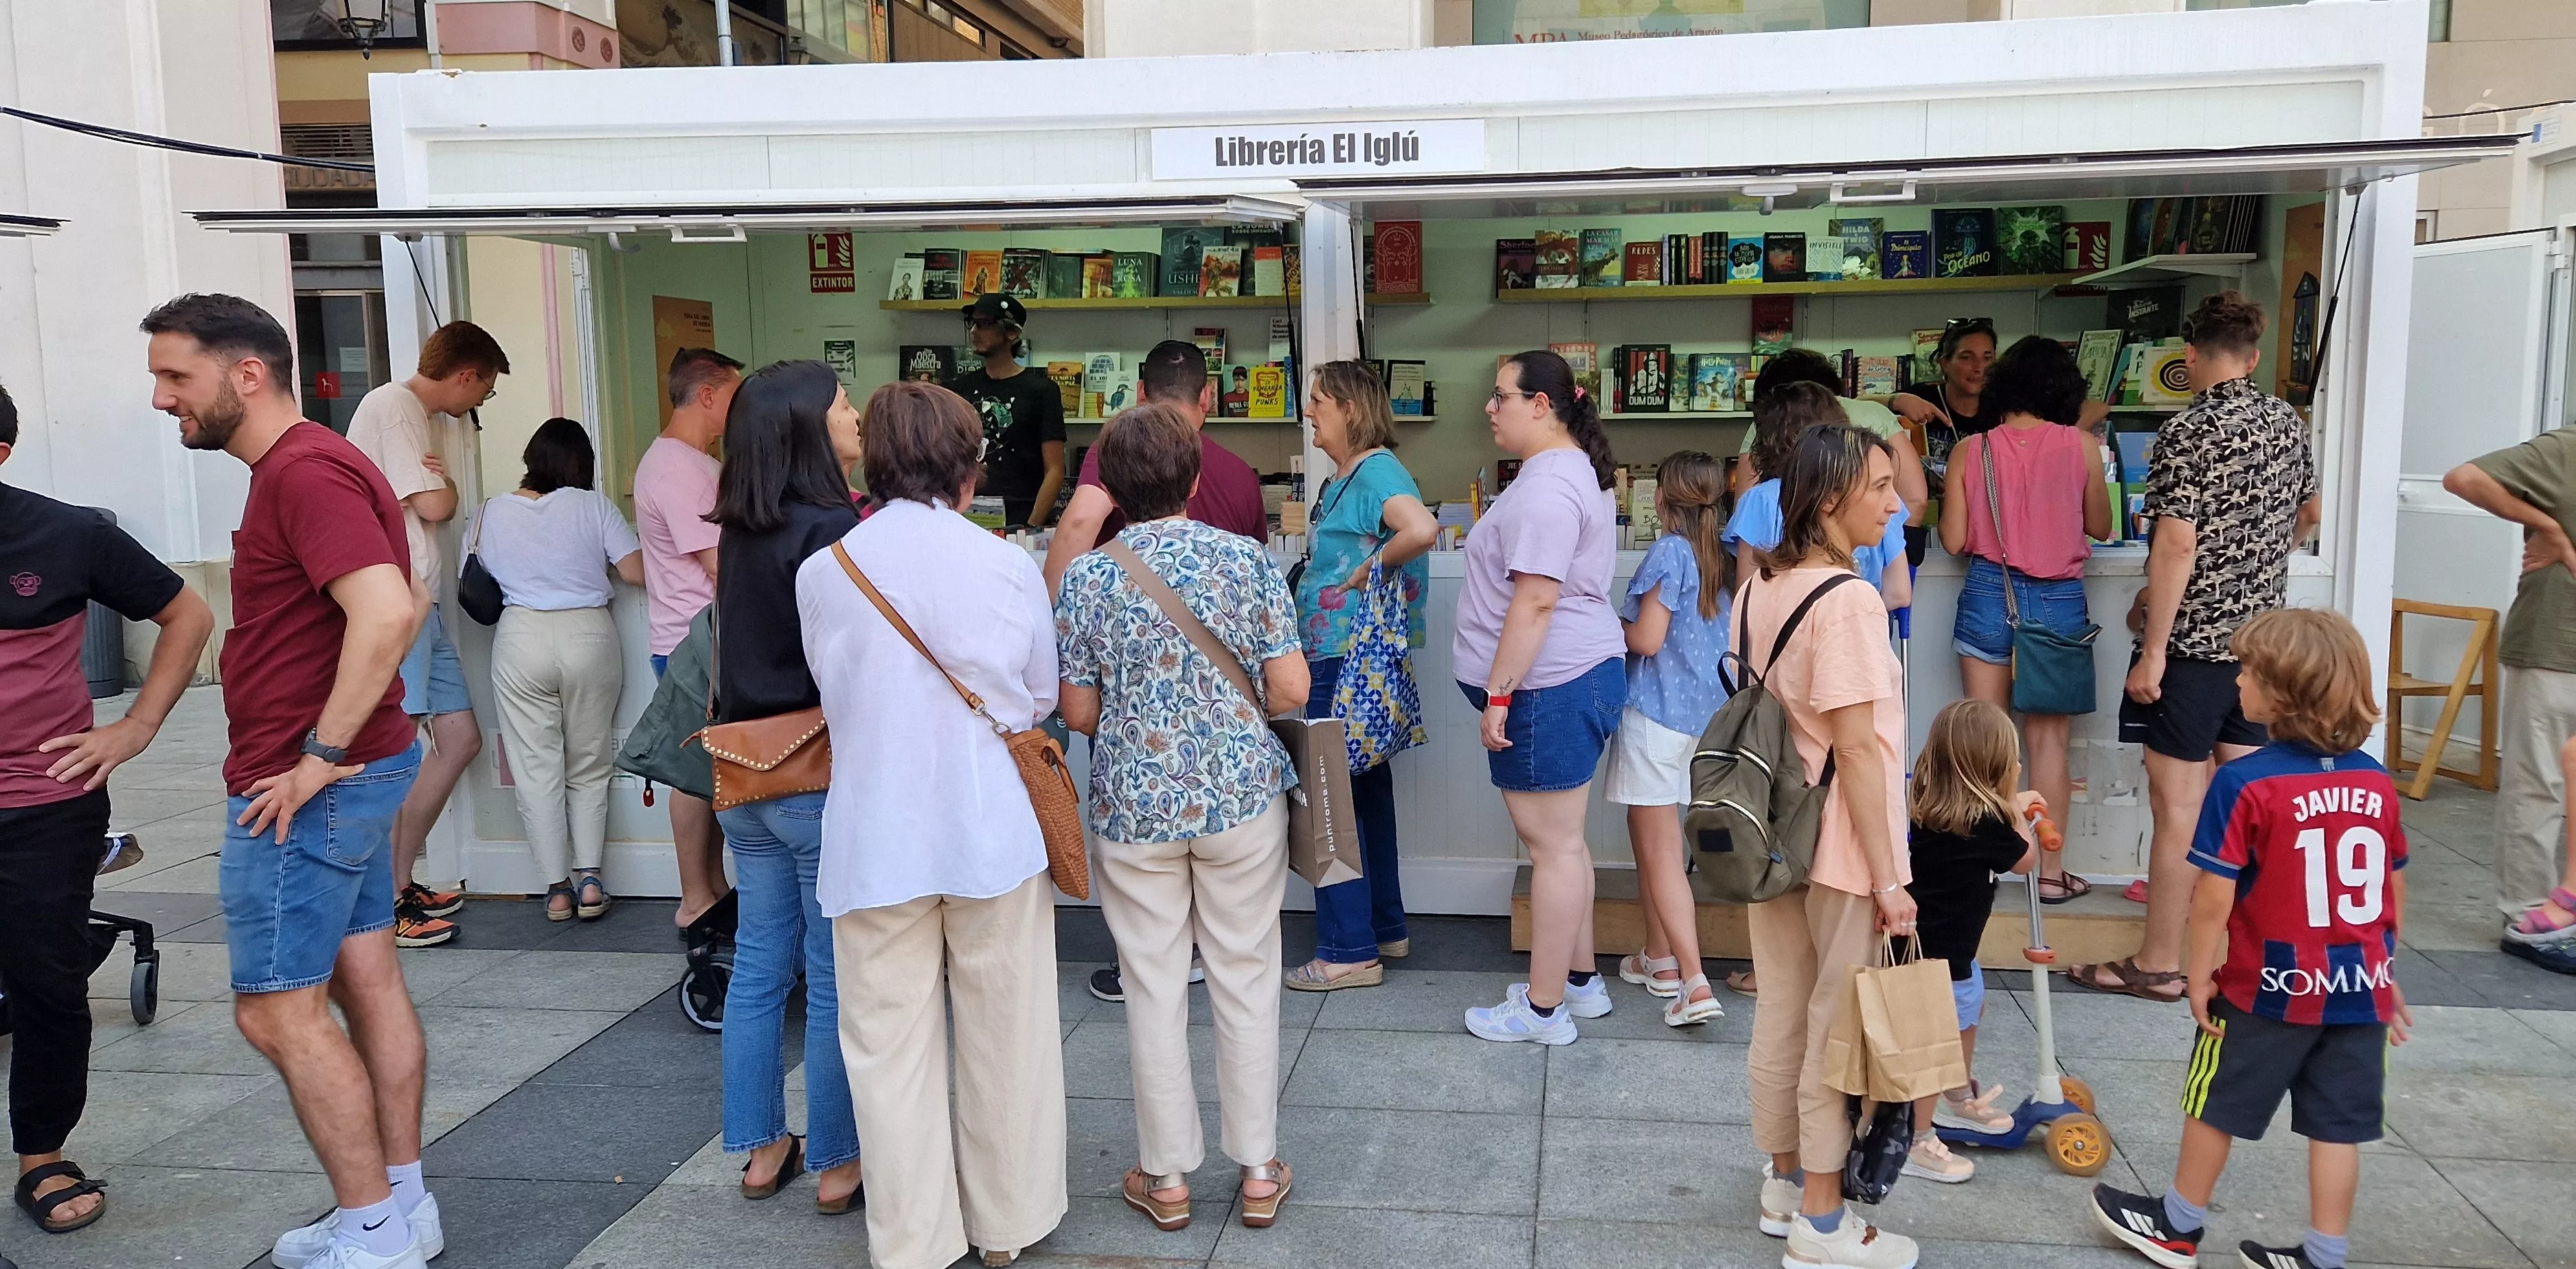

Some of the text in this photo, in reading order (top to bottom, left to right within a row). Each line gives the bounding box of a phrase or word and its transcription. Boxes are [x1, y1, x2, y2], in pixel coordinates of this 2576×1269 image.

[1579, 32, 1610, 41] Museo
[1614, 27, 1669, 39] Pedagógico
[1672, 27, 1683, 37] de
[1686, 26, 1724, 36] Aragón
[1215, 129, 1419, 167] Librería El Iglú
[1842, 225, 1871, 233] HILDA
[1631, 247, 1657, 255] REDES
[812, 276, 853, 288] EXTINTOR
[916, 351, 936, 362] Obra
[1700, 356, 1715, 367] Harry
[1716, 356, 1732, 367] Potter
[909, 358, 942, 371] Maestra
[1256, 398, 1278, 406] PUNKS
[1629, 396, 1664, 406] DUM DUM
[1319, 755, 1336, 852] puntroma.com
[2292, 786, 2384, 823] JAVIER
[2293, 825, 2387, 928] 19
